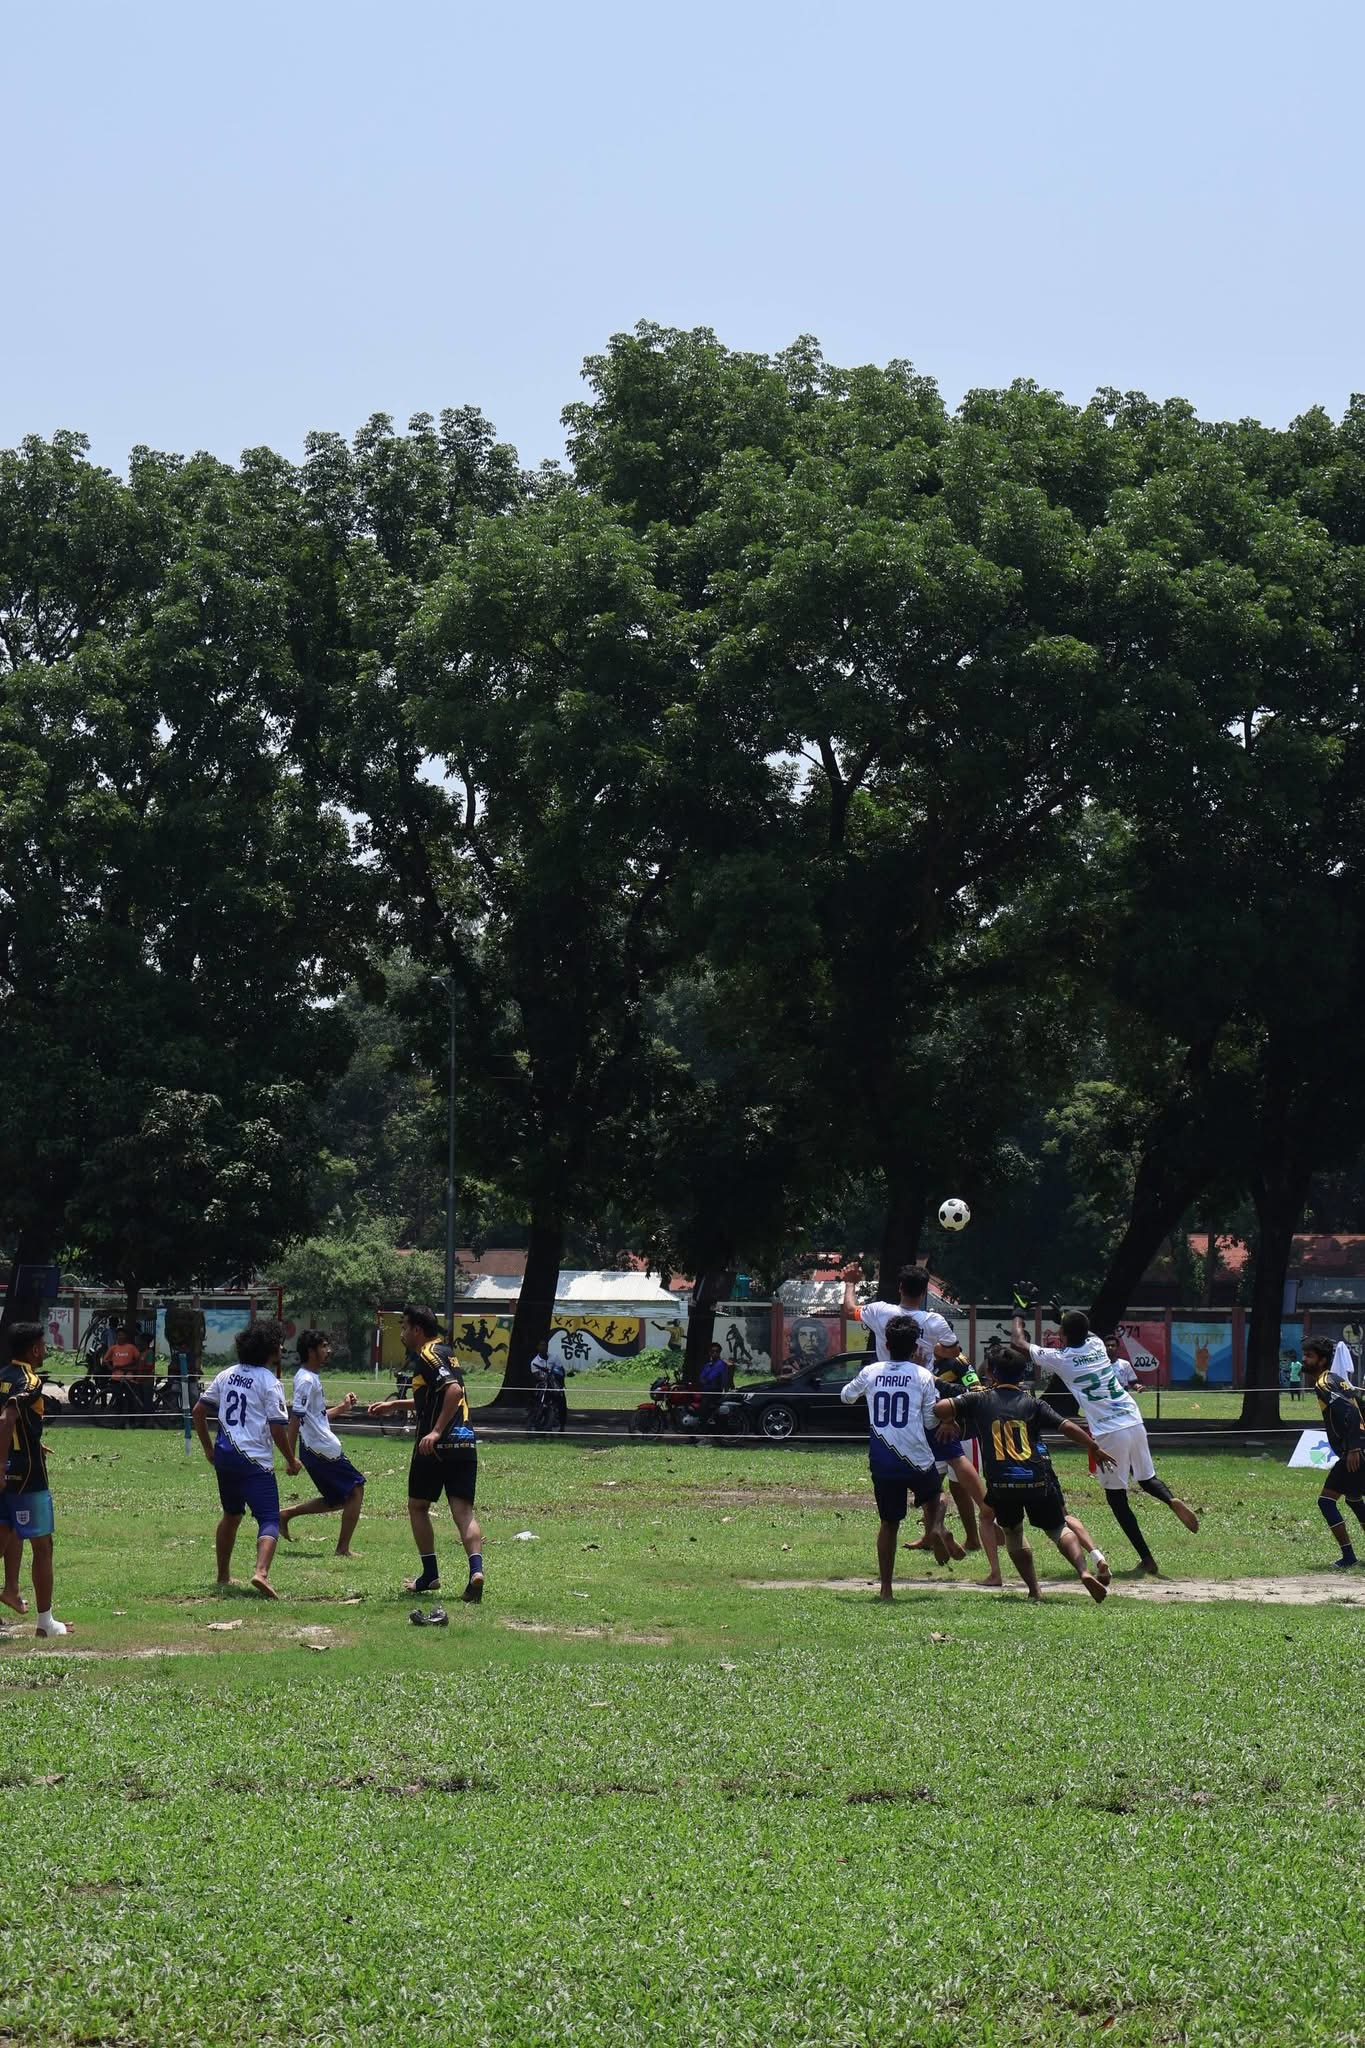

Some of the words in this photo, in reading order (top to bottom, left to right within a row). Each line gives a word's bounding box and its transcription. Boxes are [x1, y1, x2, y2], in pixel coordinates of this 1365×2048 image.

[1114, 1325, 1140, 1338] 971
[1134, 1356, 1157, 1367] 2024
[228, 1373, 253, 1389] SAKIB
[875, 1375, 911, 1387] MARUF
[1073, 1365, 1125, 1401] 22
[225, 1390, 247, 1428] 21
[873, 1391, 910, 1428] 00
[991, 1419, 1032, 1461] 10
